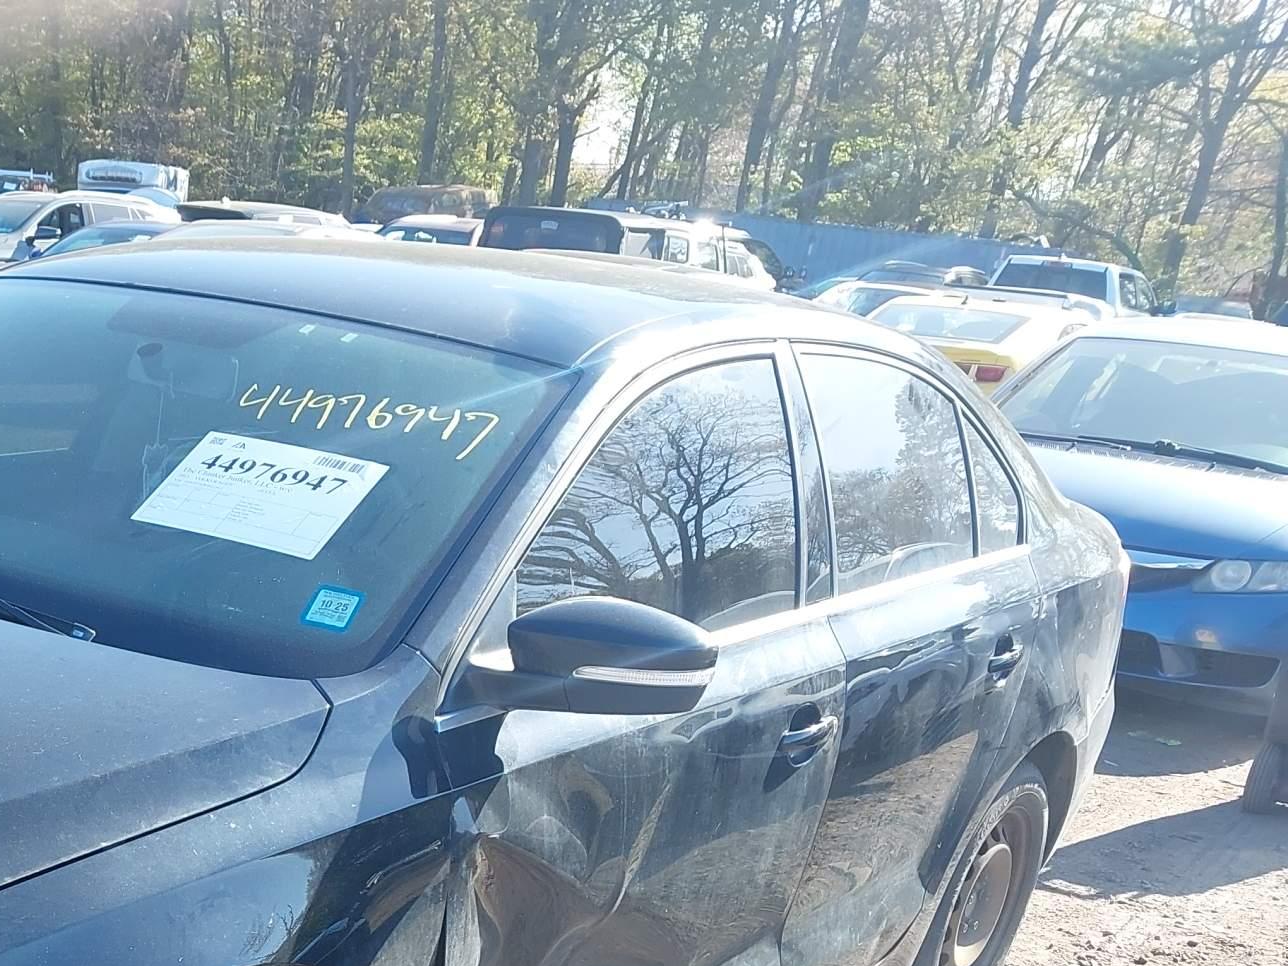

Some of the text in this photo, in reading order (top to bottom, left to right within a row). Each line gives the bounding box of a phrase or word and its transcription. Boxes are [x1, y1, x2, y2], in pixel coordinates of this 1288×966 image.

[239, 383, 500, 460] 44976947
[201, 453, 348, 495] 44976947
[321, 600, 349, 612] 10 25
